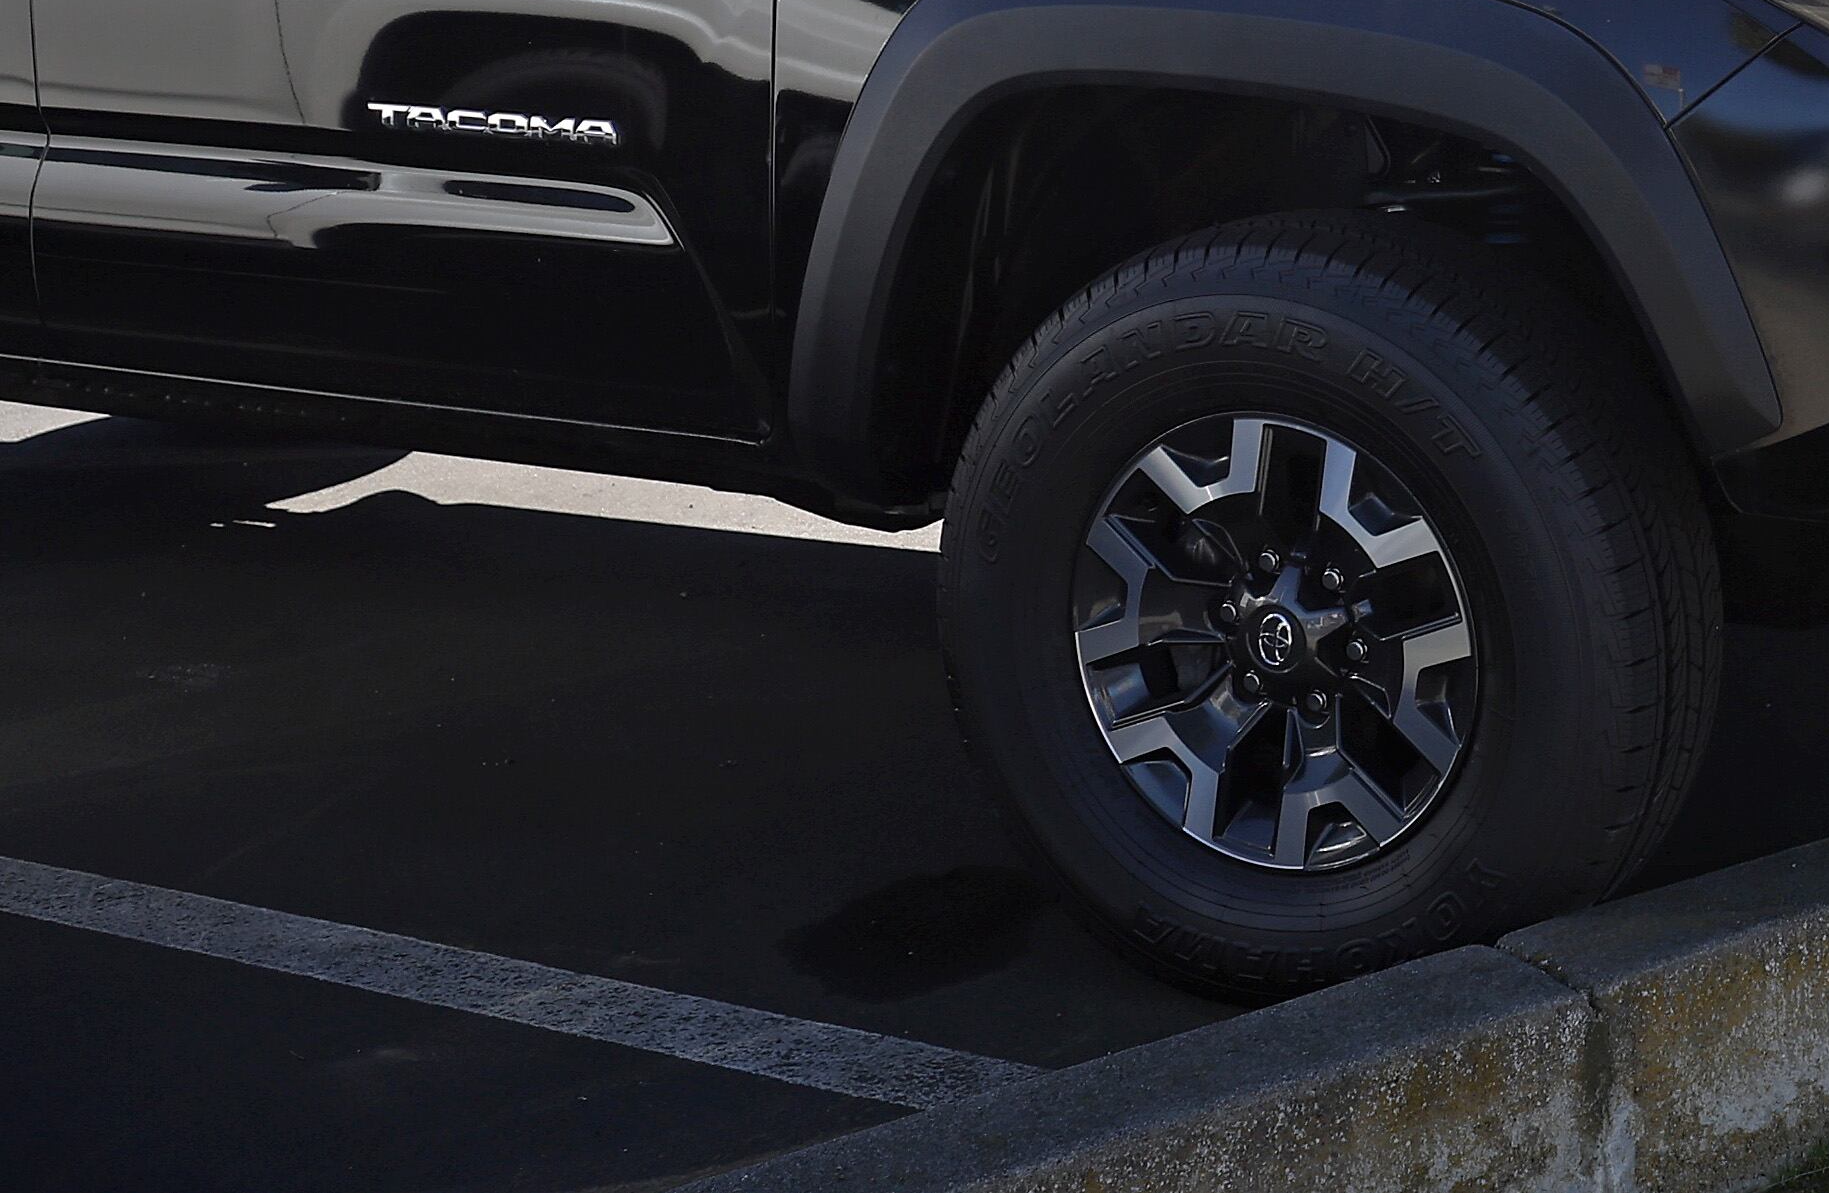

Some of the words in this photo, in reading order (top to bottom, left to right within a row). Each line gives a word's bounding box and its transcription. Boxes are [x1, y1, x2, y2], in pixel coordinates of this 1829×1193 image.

[367, 101, 619, 145] TACOMA
[977, 310, 1328, 564] GEOLANDAR
[1345, 348, 1484, 459] H/T
